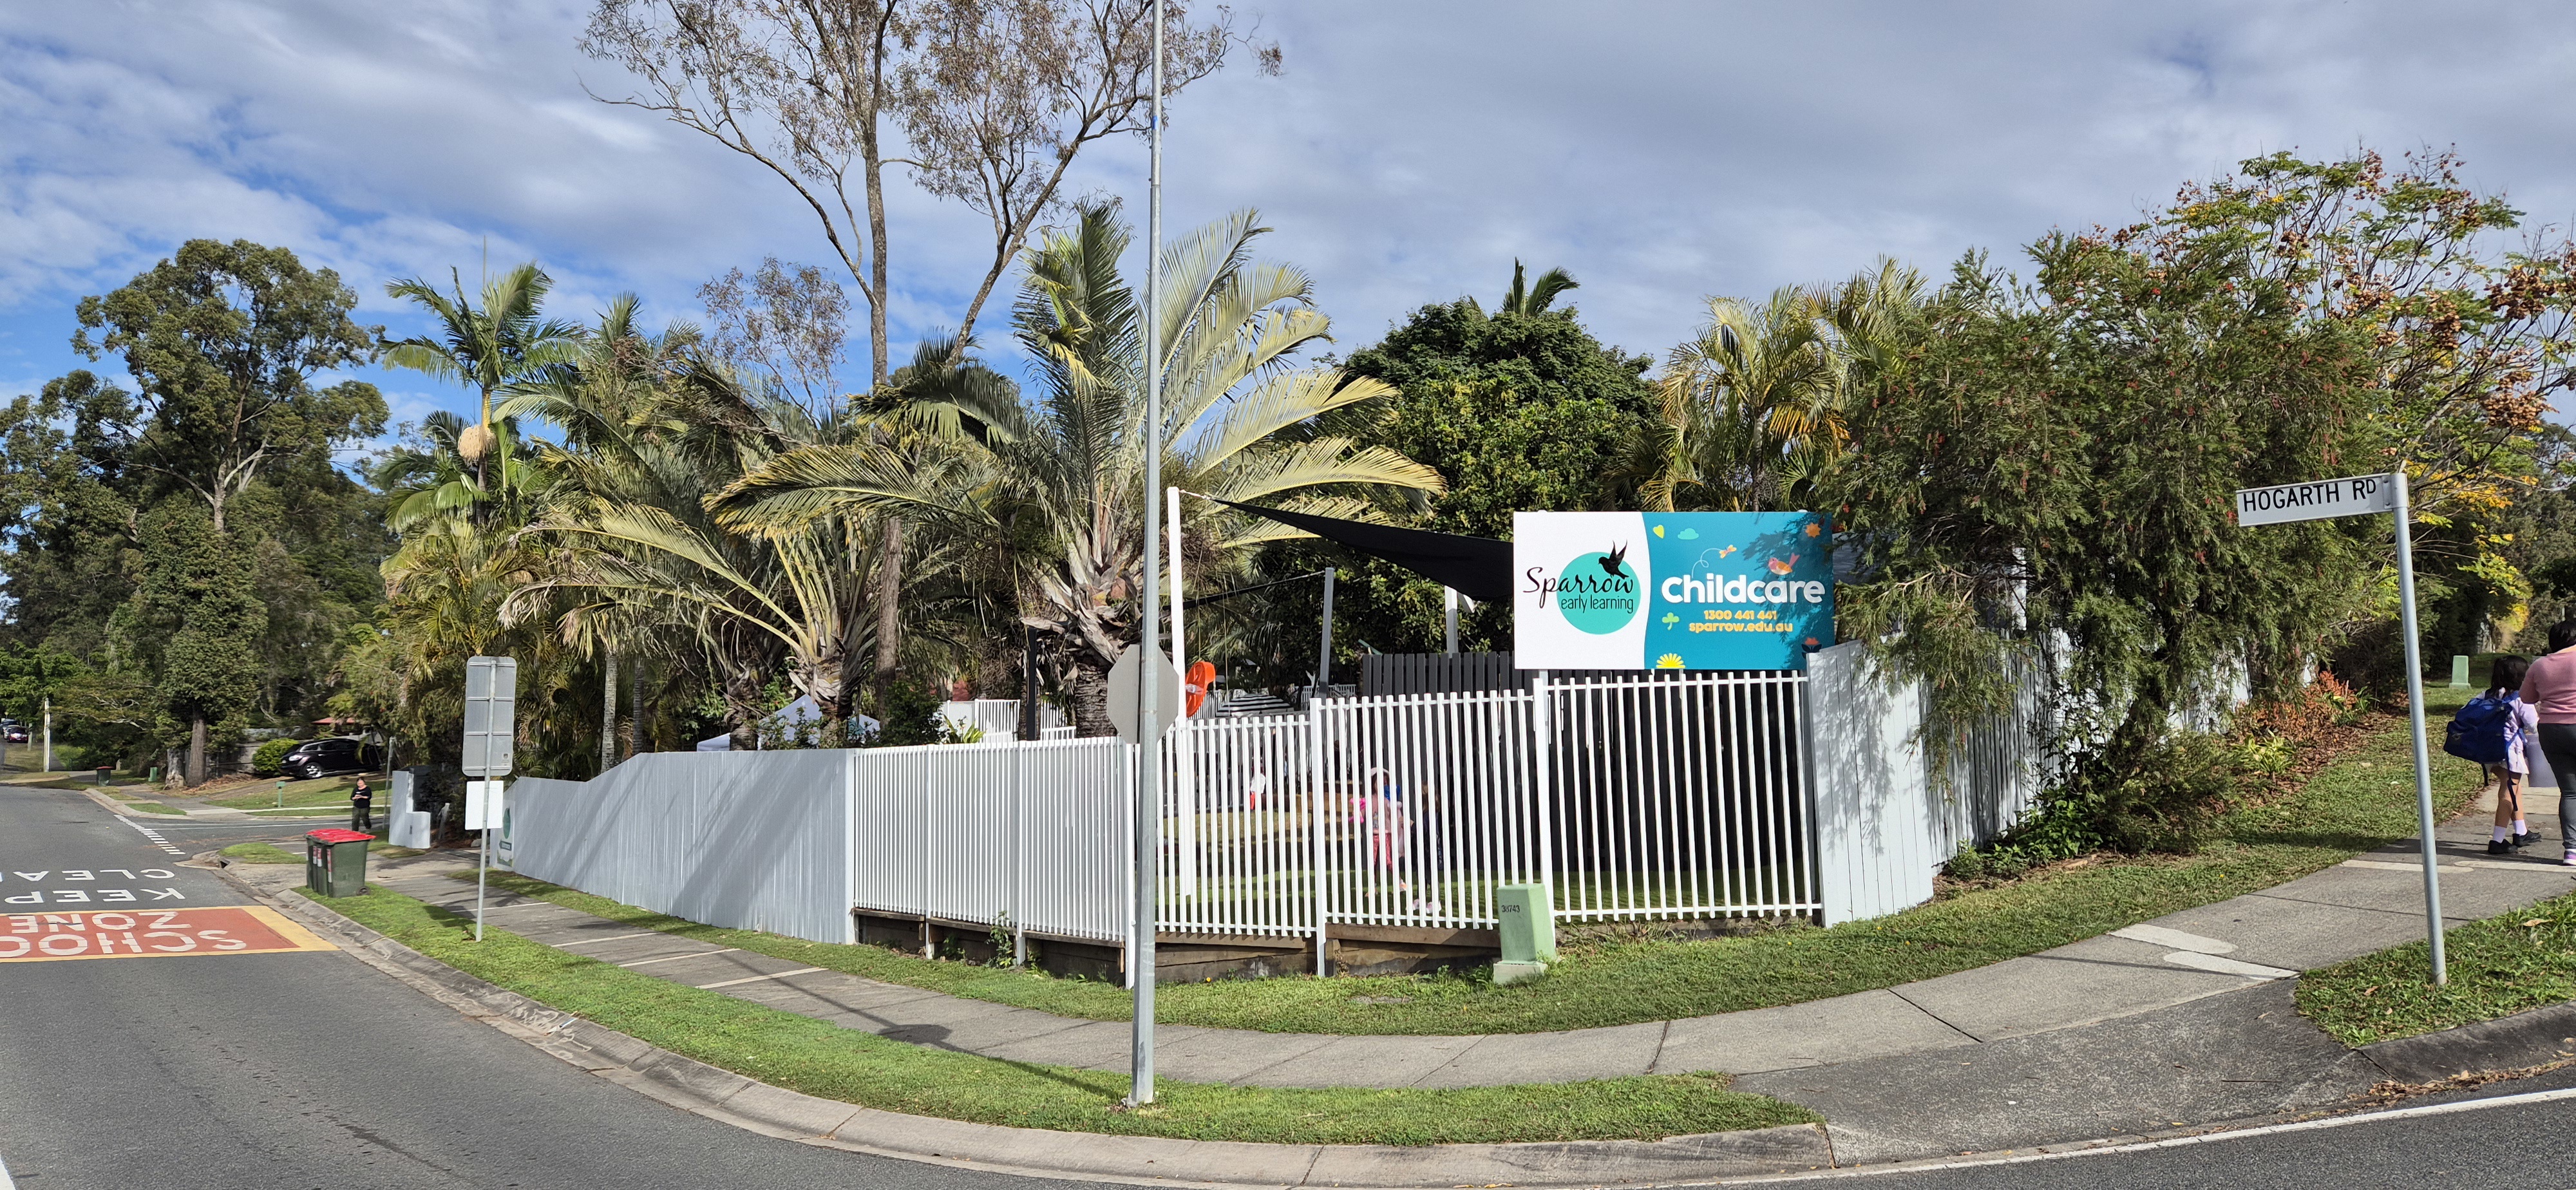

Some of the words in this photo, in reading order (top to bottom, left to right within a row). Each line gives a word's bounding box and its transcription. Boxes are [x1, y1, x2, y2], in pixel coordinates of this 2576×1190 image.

[2243, 482, 2340, 512] HOGARTH
[2353, 479, 2376, 500] RD
[1523, 567, 1634, 609] Sparrow
[1661, 573, 1826, 603] Childcare
[1561, 594, 1587, 613] early
[1590, 594, 1634, 614] learning
[1703, 610, 1732, 620] 1300
[1734, 610, 1754, 620] 441
[1757, 610, 1777, 620] 441
[1689, 621, 1794, 633] sparrow.edu.au
[0, 869, 175, 882] CLEA
[5, 887, 185, 904] KEEP
[8, 911, 192, 934] ZONE
[0, 930, 247, 958] SCHOO
